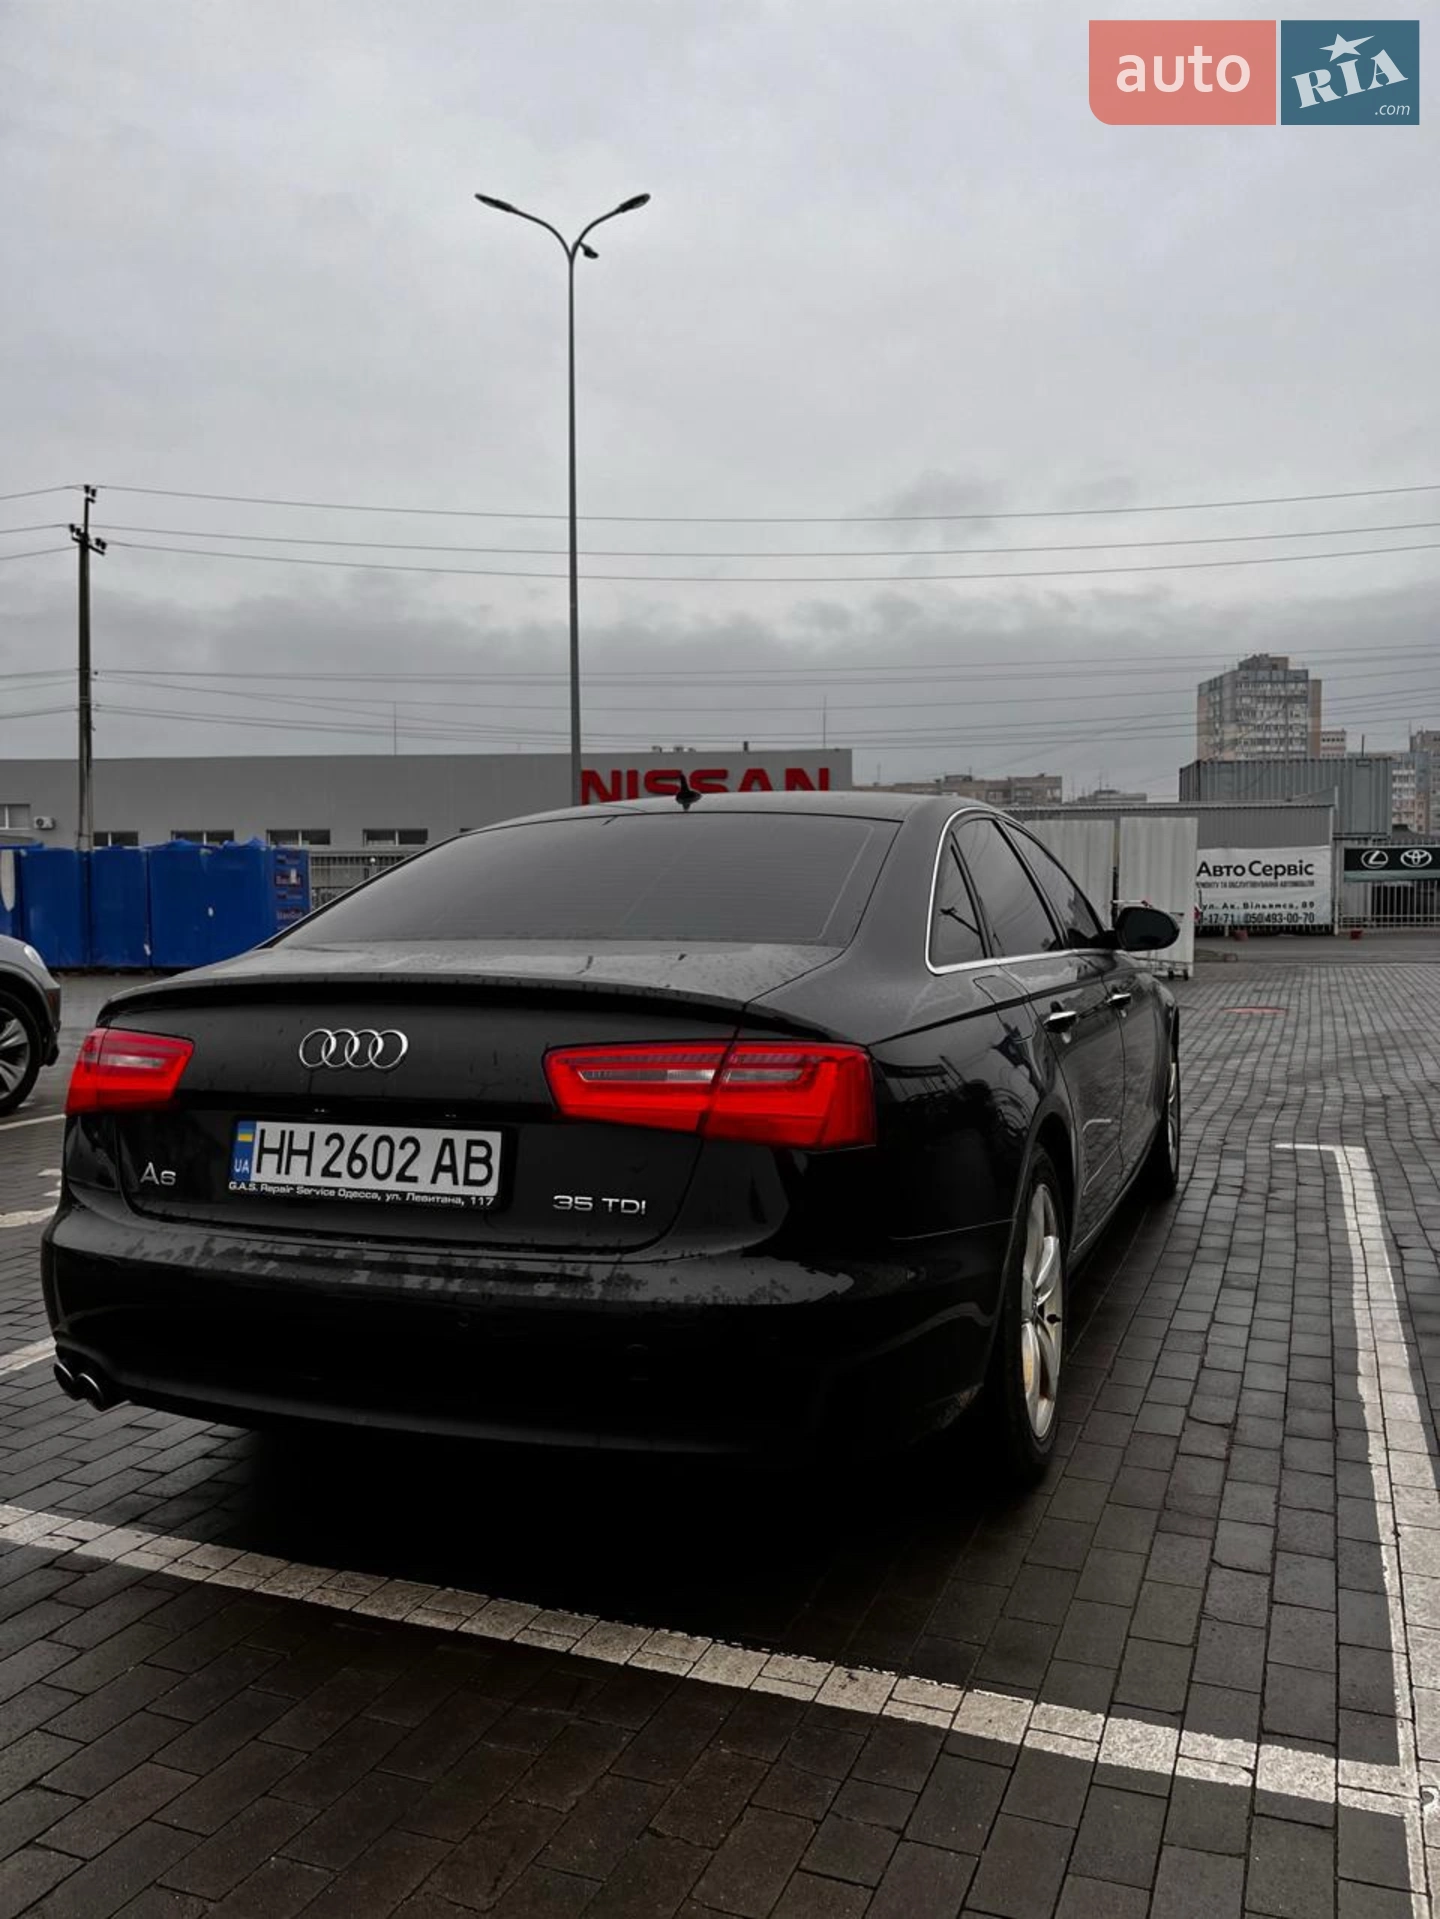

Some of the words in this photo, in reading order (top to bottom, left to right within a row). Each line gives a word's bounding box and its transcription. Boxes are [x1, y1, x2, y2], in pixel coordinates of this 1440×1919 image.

[581, 768, 829, 805] NISSAN
[233, 1157, 250, 1174] UA
[260, 1183, 294, 1195] Repair
[296, 1185, 336, 1197] Service
[470, 1196, 495, 1207] 117
[552, 1195, 593, 1212] 35
[601, 1197, 647, 1216] TDI
